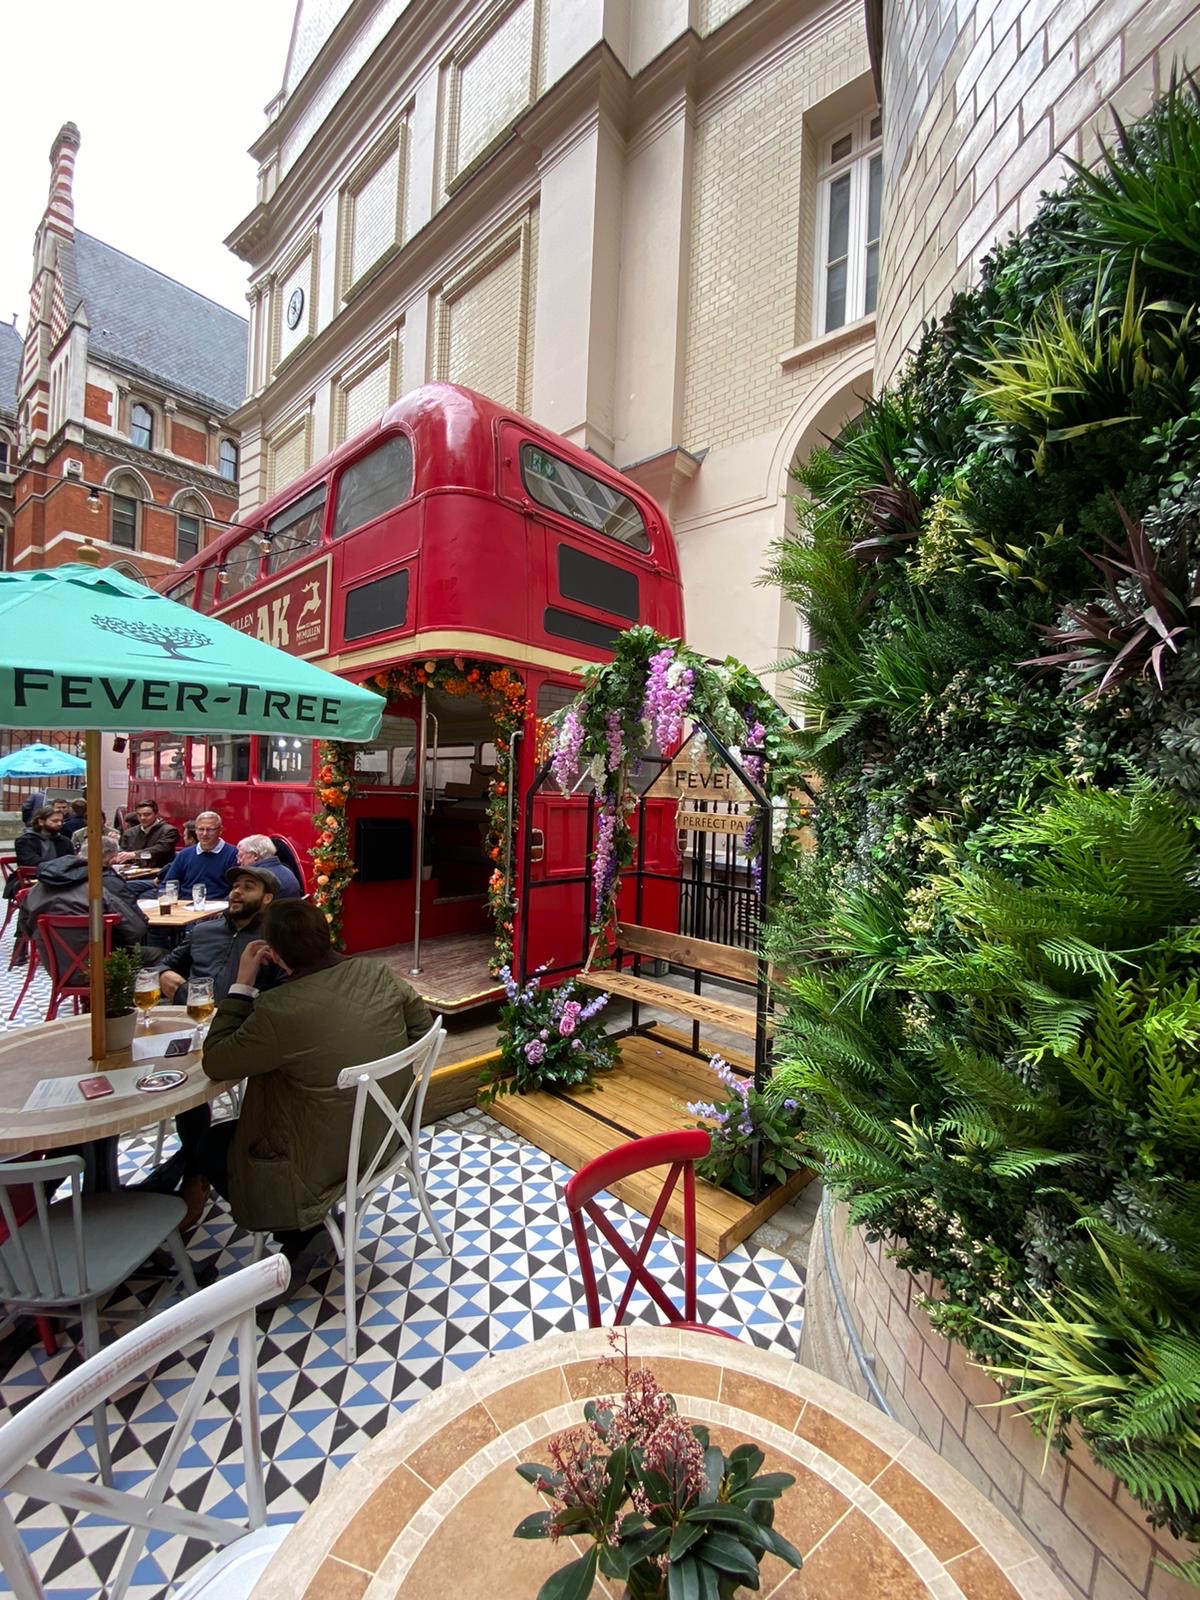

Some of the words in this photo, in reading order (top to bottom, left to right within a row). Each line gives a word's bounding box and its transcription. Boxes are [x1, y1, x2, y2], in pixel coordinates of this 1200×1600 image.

[257, 594, 291, 649] AK
[13, 667, 341, 725] FEVER-TREE
[682, 816, 726, 830] PERFECT
[607, 976, 744, 1022] FEVER-TREE
